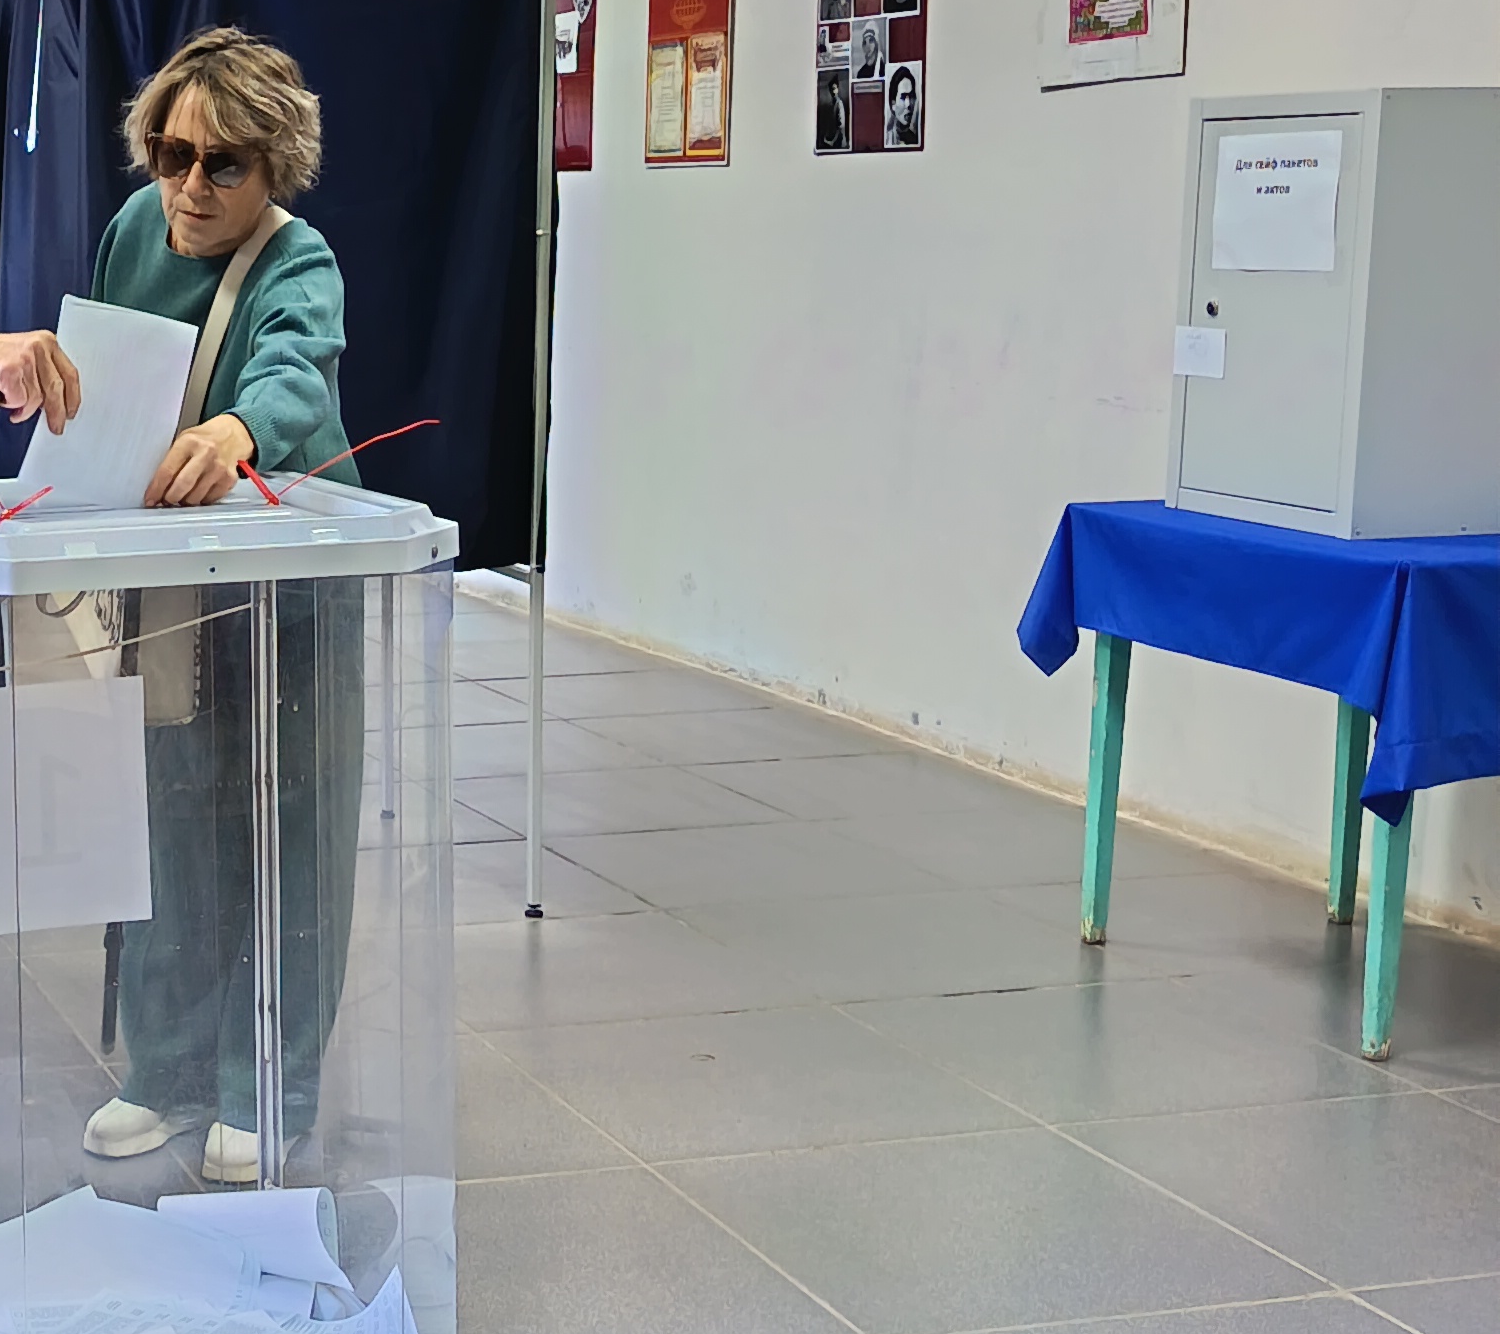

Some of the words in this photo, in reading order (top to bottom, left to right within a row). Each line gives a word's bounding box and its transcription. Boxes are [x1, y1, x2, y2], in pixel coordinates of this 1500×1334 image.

[1234, 159, 1253, 174] Для
[1280, 158, 1319, 169] пакетов
[1264, 185, 1291, 195] актов
